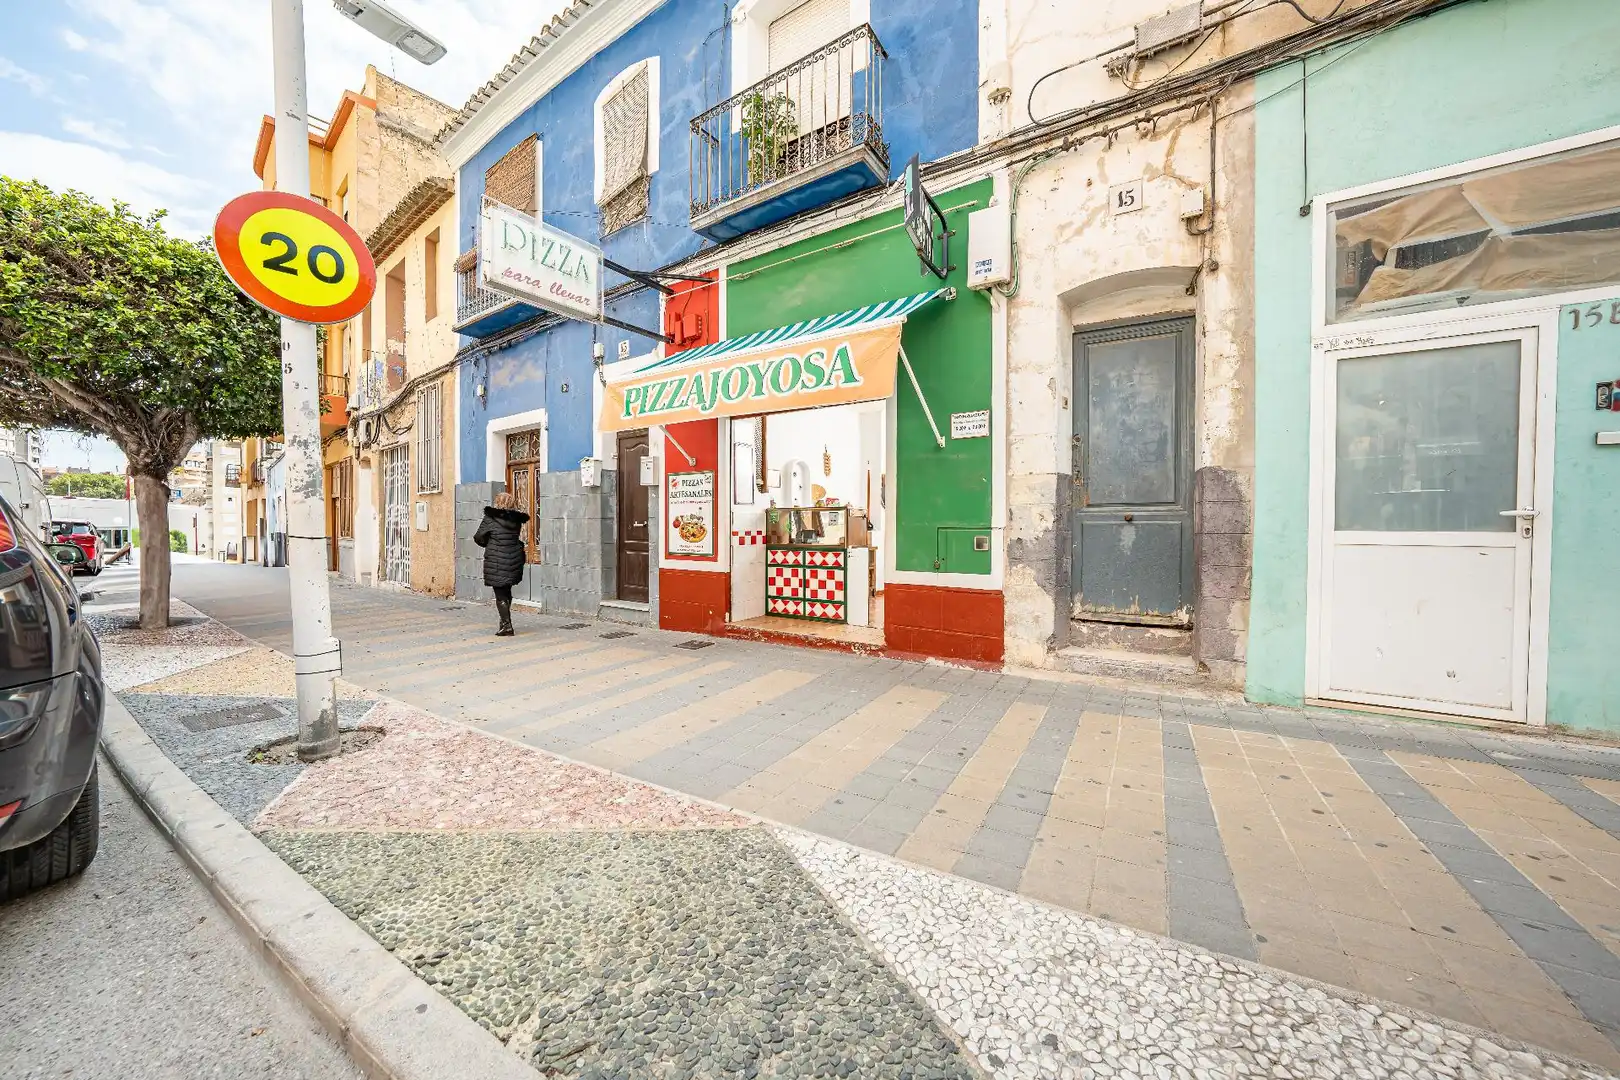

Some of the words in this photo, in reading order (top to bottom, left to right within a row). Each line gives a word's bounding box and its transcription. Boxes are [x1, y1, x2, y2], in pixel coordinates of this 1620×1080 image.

[1117, 188, 1135, 208] 15
[260, 231, 345, 284] 20
[501, 219, 592, 284] PIZZA
[502, 267, 543, 289] para
[549, 281, 592, 306] llevar
[621, 345, 860, 418] PIZZAJOYOSA
[669, 489, 712, 499] ARTESANALES
[681, 478, 704, 487] PIZZAS
